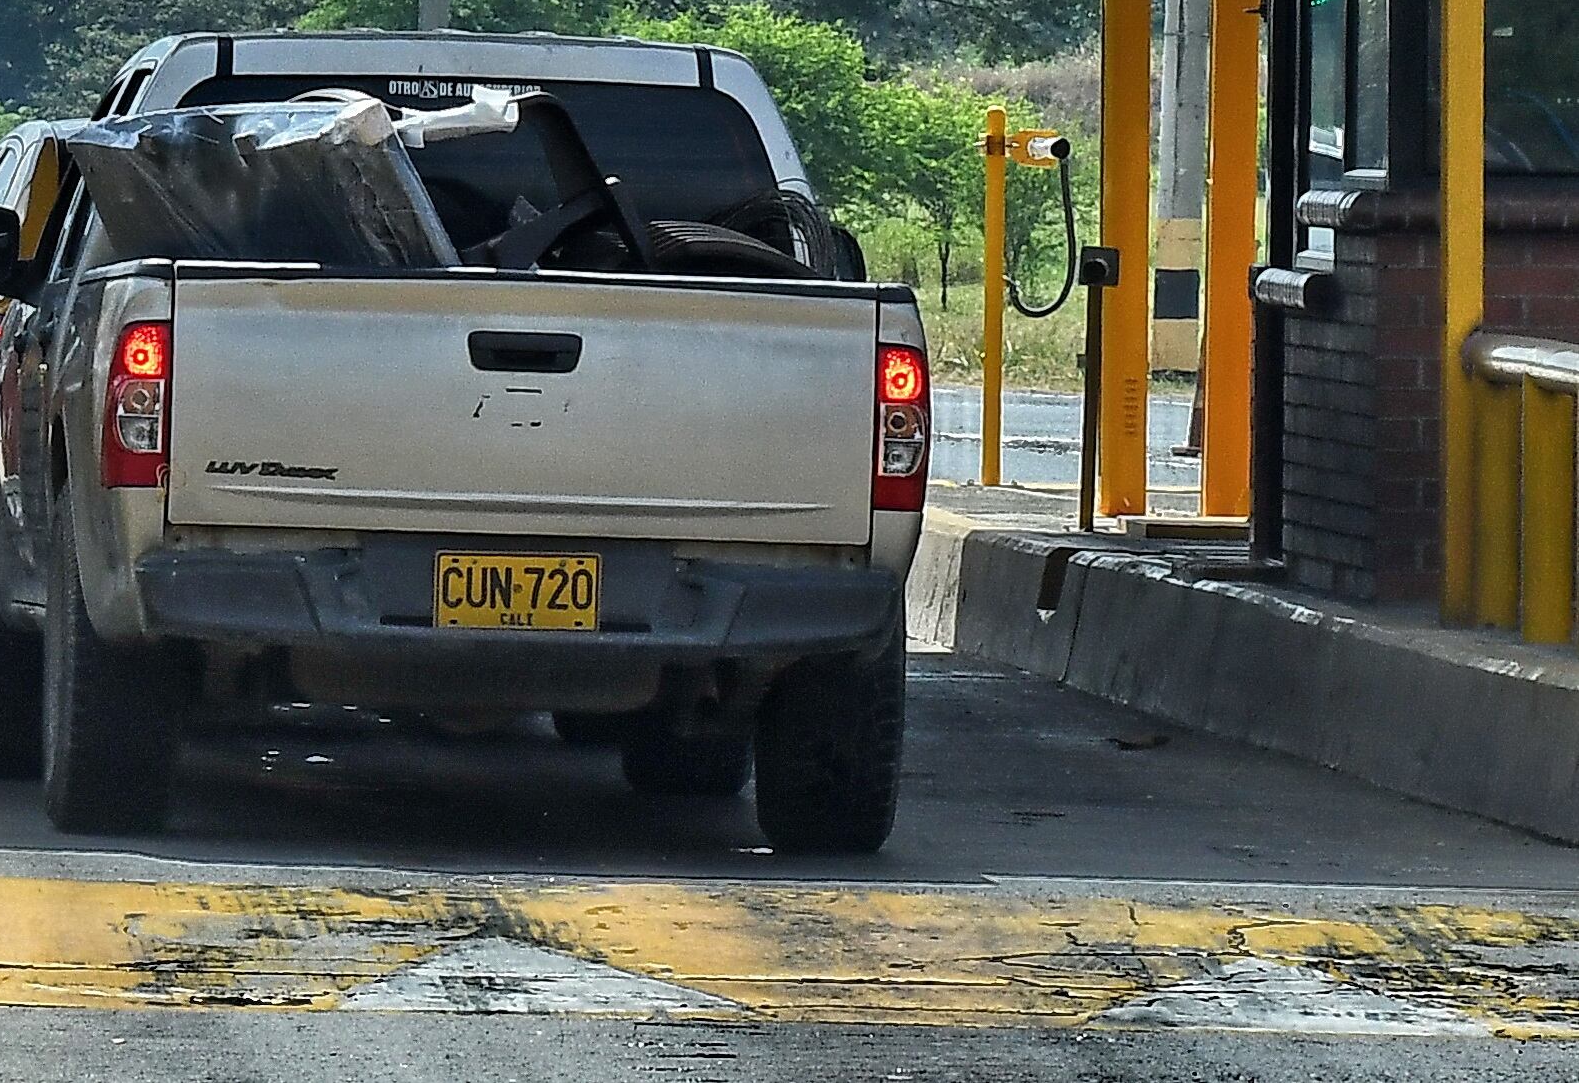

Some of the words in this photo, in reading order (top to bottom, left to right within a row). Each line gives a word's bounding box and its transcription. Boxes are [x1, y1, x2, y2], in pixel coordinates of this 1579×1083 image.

[388, 80, 419, 95] OTRO
[439, 82, 453, 96] DE
[500, 612, 533, 626] CALI
